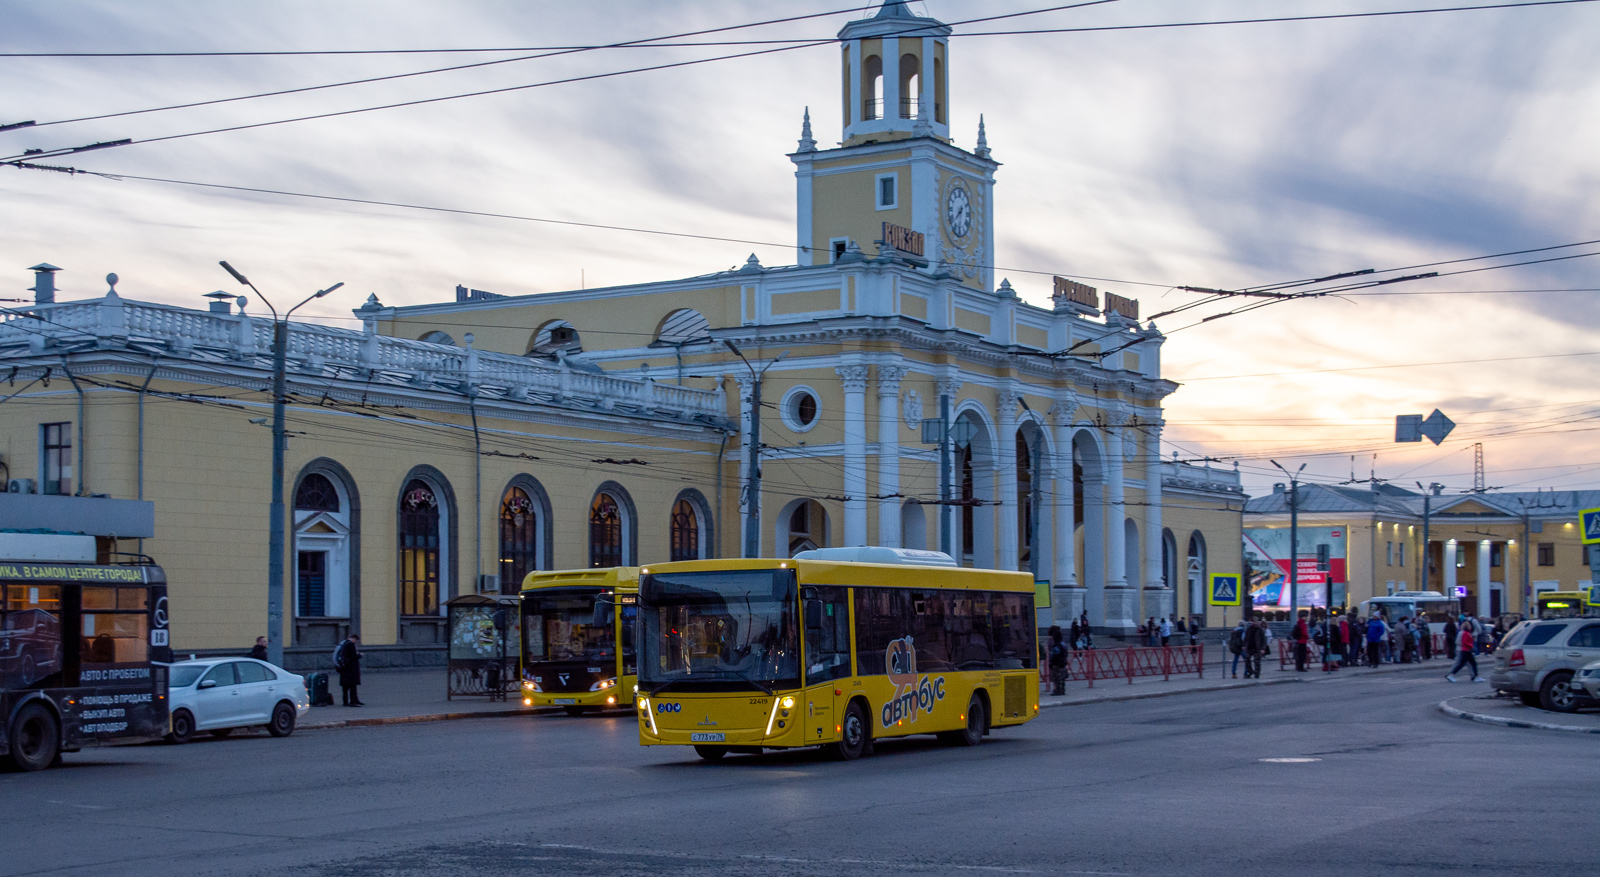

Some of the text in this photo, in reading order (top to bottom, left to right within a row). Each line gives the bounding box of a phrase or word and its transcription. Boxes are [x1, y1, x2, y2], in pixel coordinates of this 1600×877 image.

[882, 222, 925, 256] ВОКЗАЛ
[23, 566, 31, 578] В
[32, 566, 67, 578] САМОМ
[68, 567, 103, 580] ЦЕНТРЕ
[104, 569, 142, 581] ГОРОДА!
[155, 632, 165, 643] 18
[80, 668, 150, 680] АВТО С ПРОБЕГОМ
[83, 695, 113, 705] ПОМОЩЬ
[120, 693, 152, 704] ПРОДАЖЕ
[83, 708, 126, 719] ВЫКУП АВТО
[83, 722, 128, 733] АВТОПОДБОР
